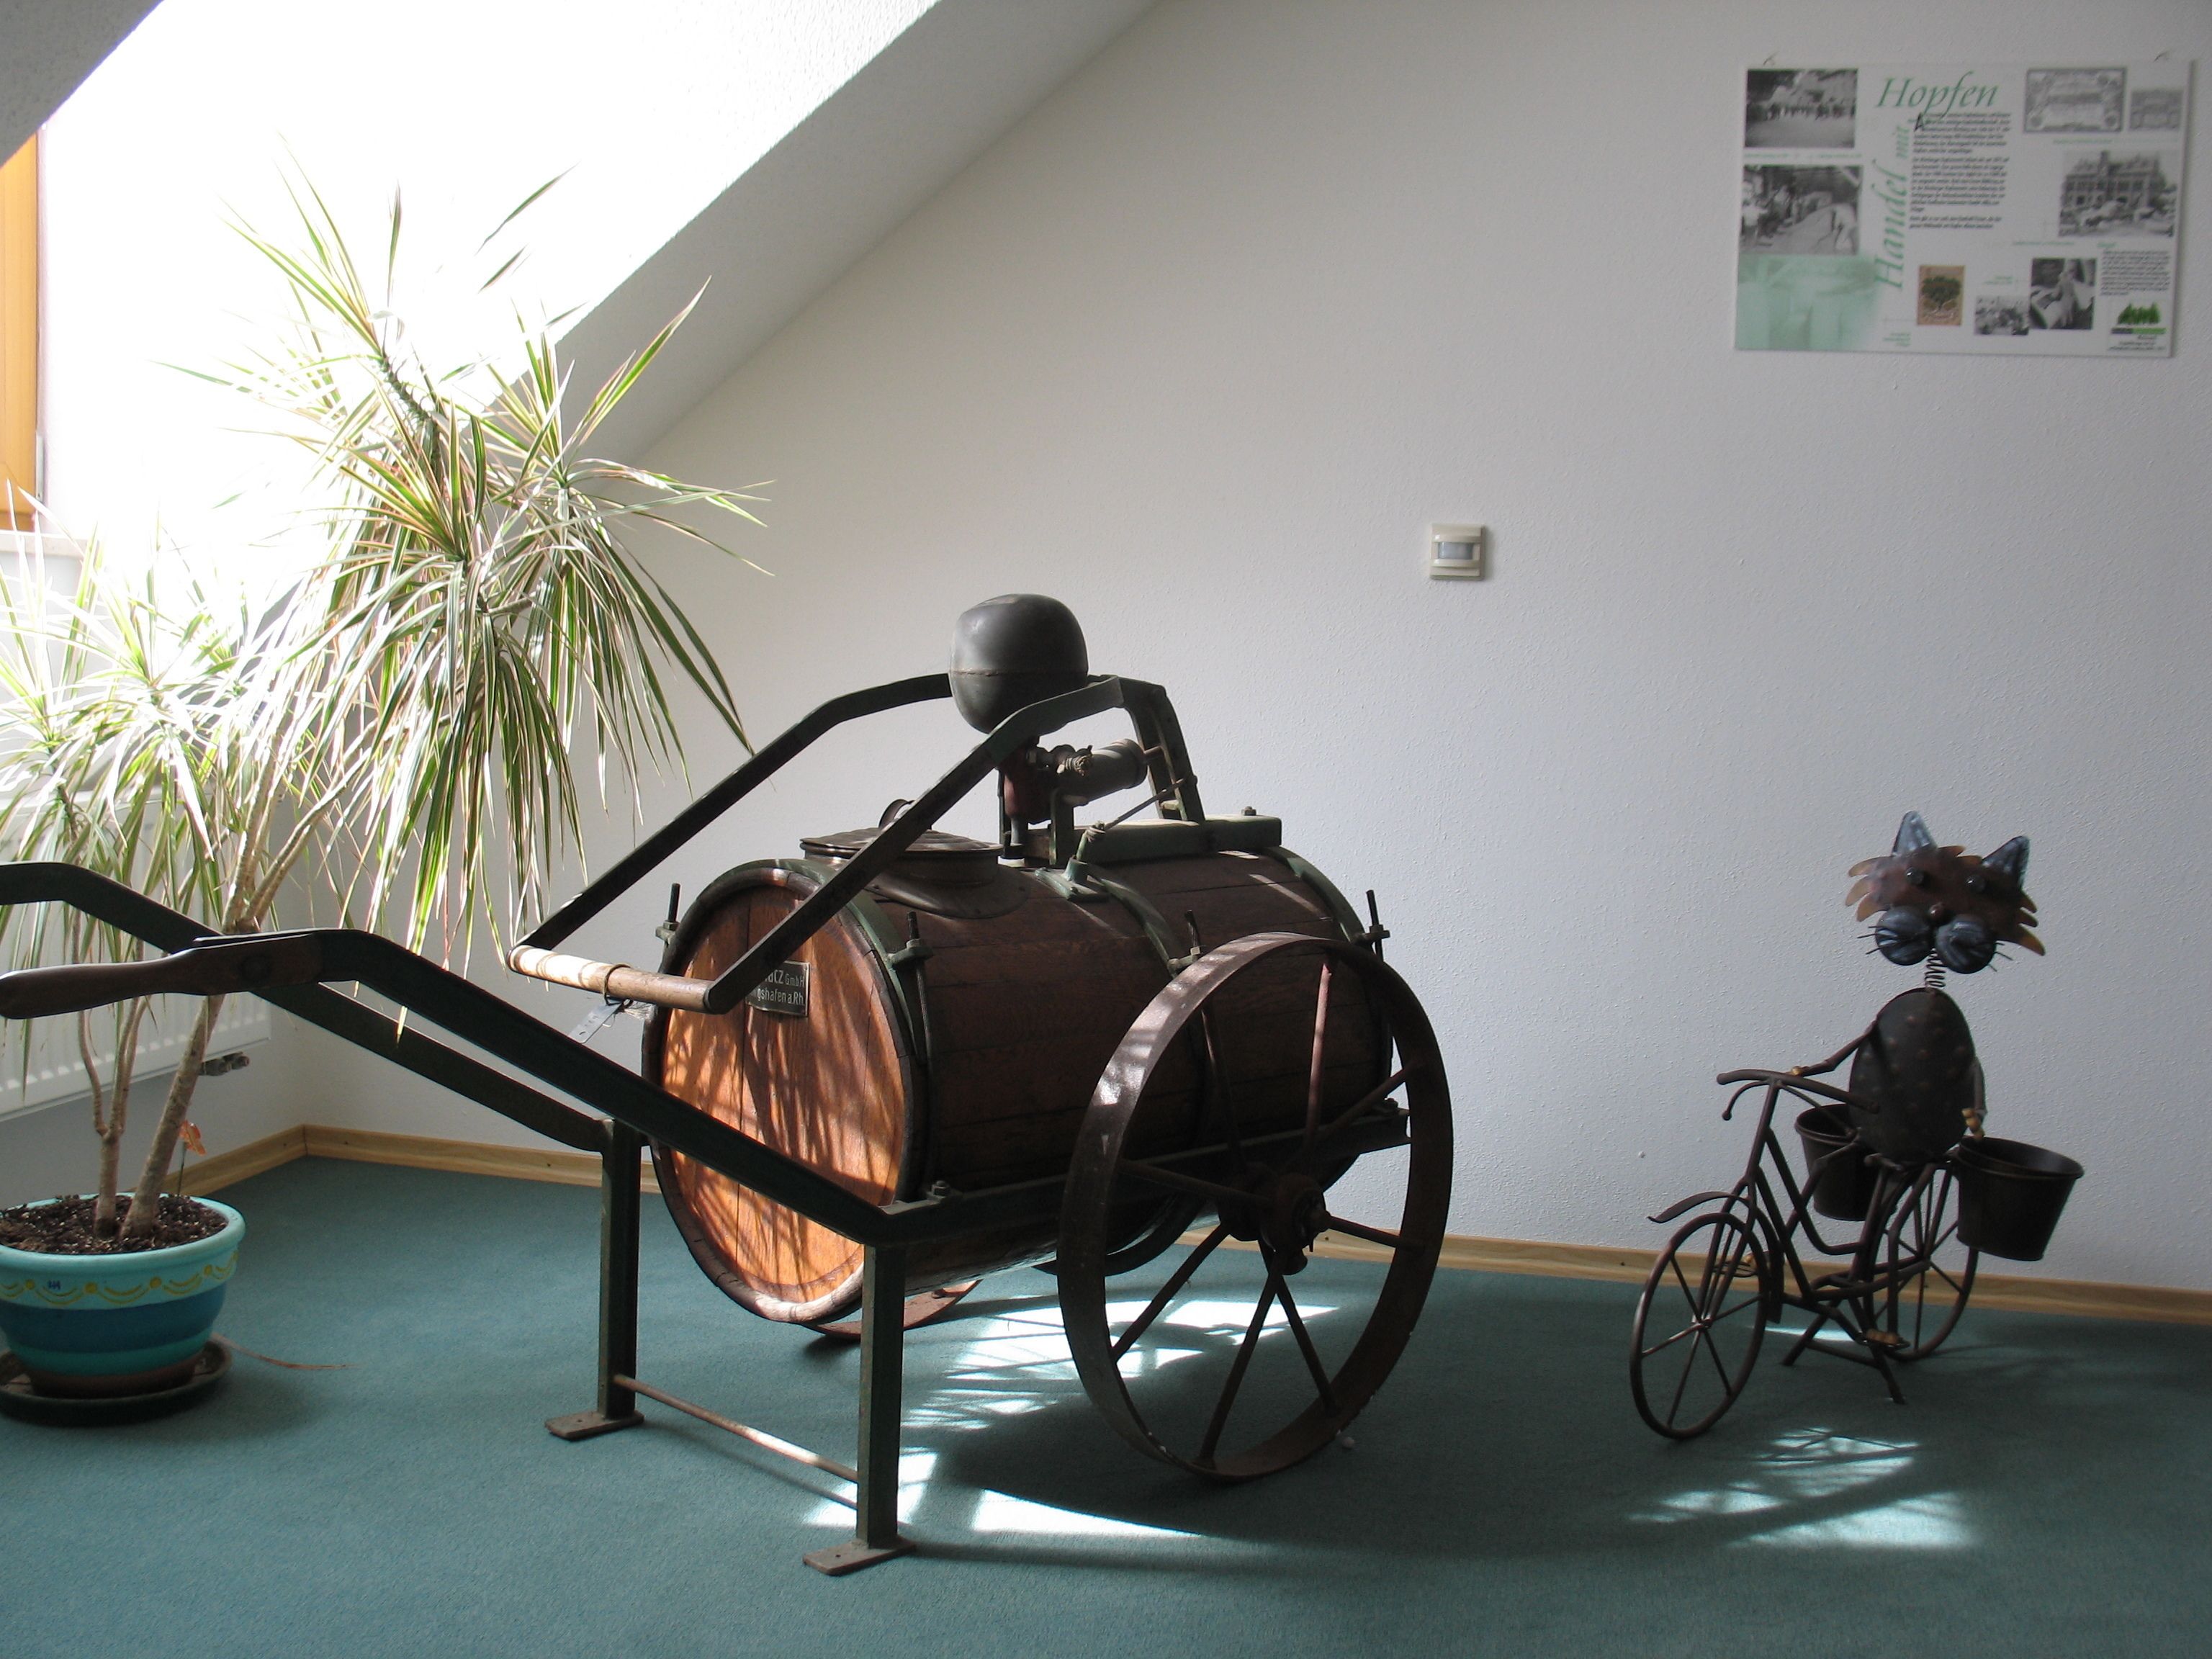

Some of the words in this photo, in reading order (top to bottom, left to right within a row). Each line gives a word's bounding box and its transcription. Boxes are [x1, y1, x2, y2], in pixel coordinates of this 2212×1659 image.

[1876, 71, 1999, 121] Hopfen
[1871, 158, 1907, 289] Handel
[757, 987, 787, 1003] gshafen
[785, 973, 805, 988] GmbH
